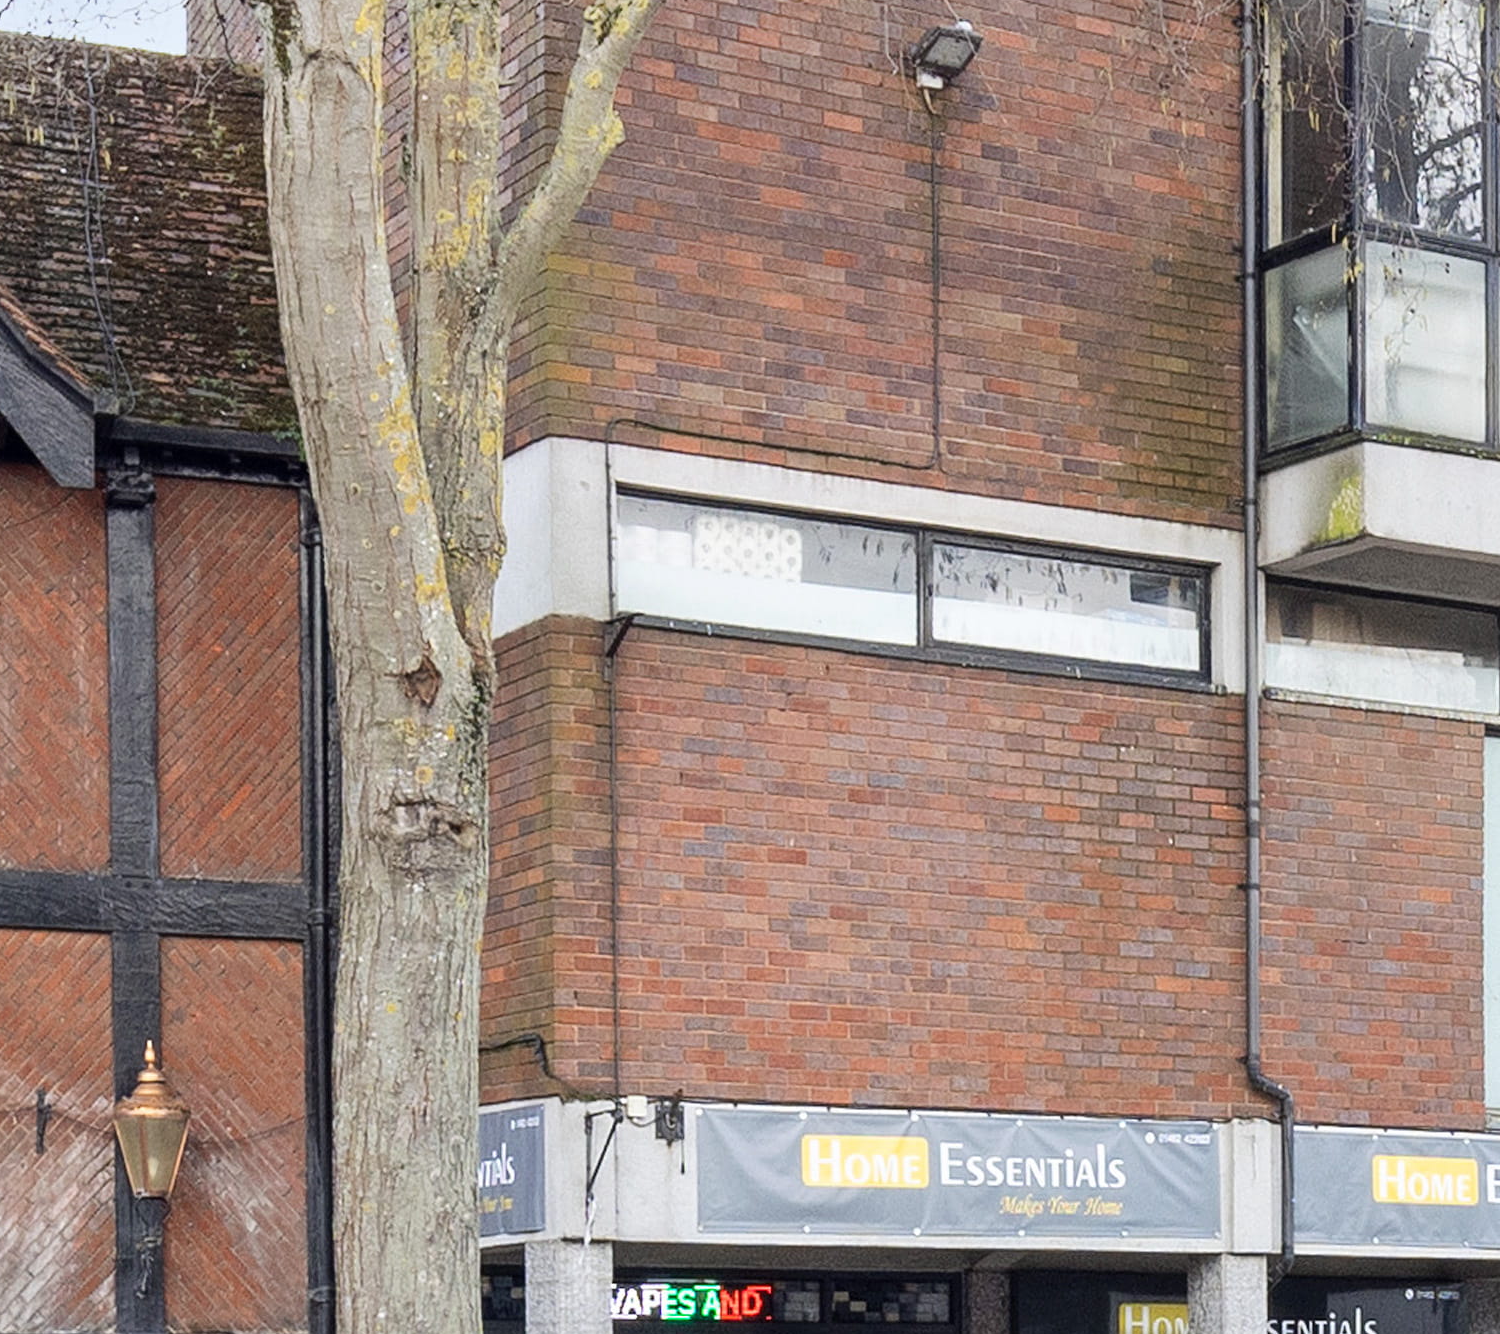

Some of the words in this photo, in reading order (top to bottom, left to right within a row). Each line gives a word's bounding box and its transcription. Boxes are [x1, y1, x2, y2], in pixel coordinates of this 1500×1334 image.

[1001, 1196, 1045, 1218] Makes
[1048, 1197, 1081, 1216] Your
[1084, 1198, 1123, 1216] Home
